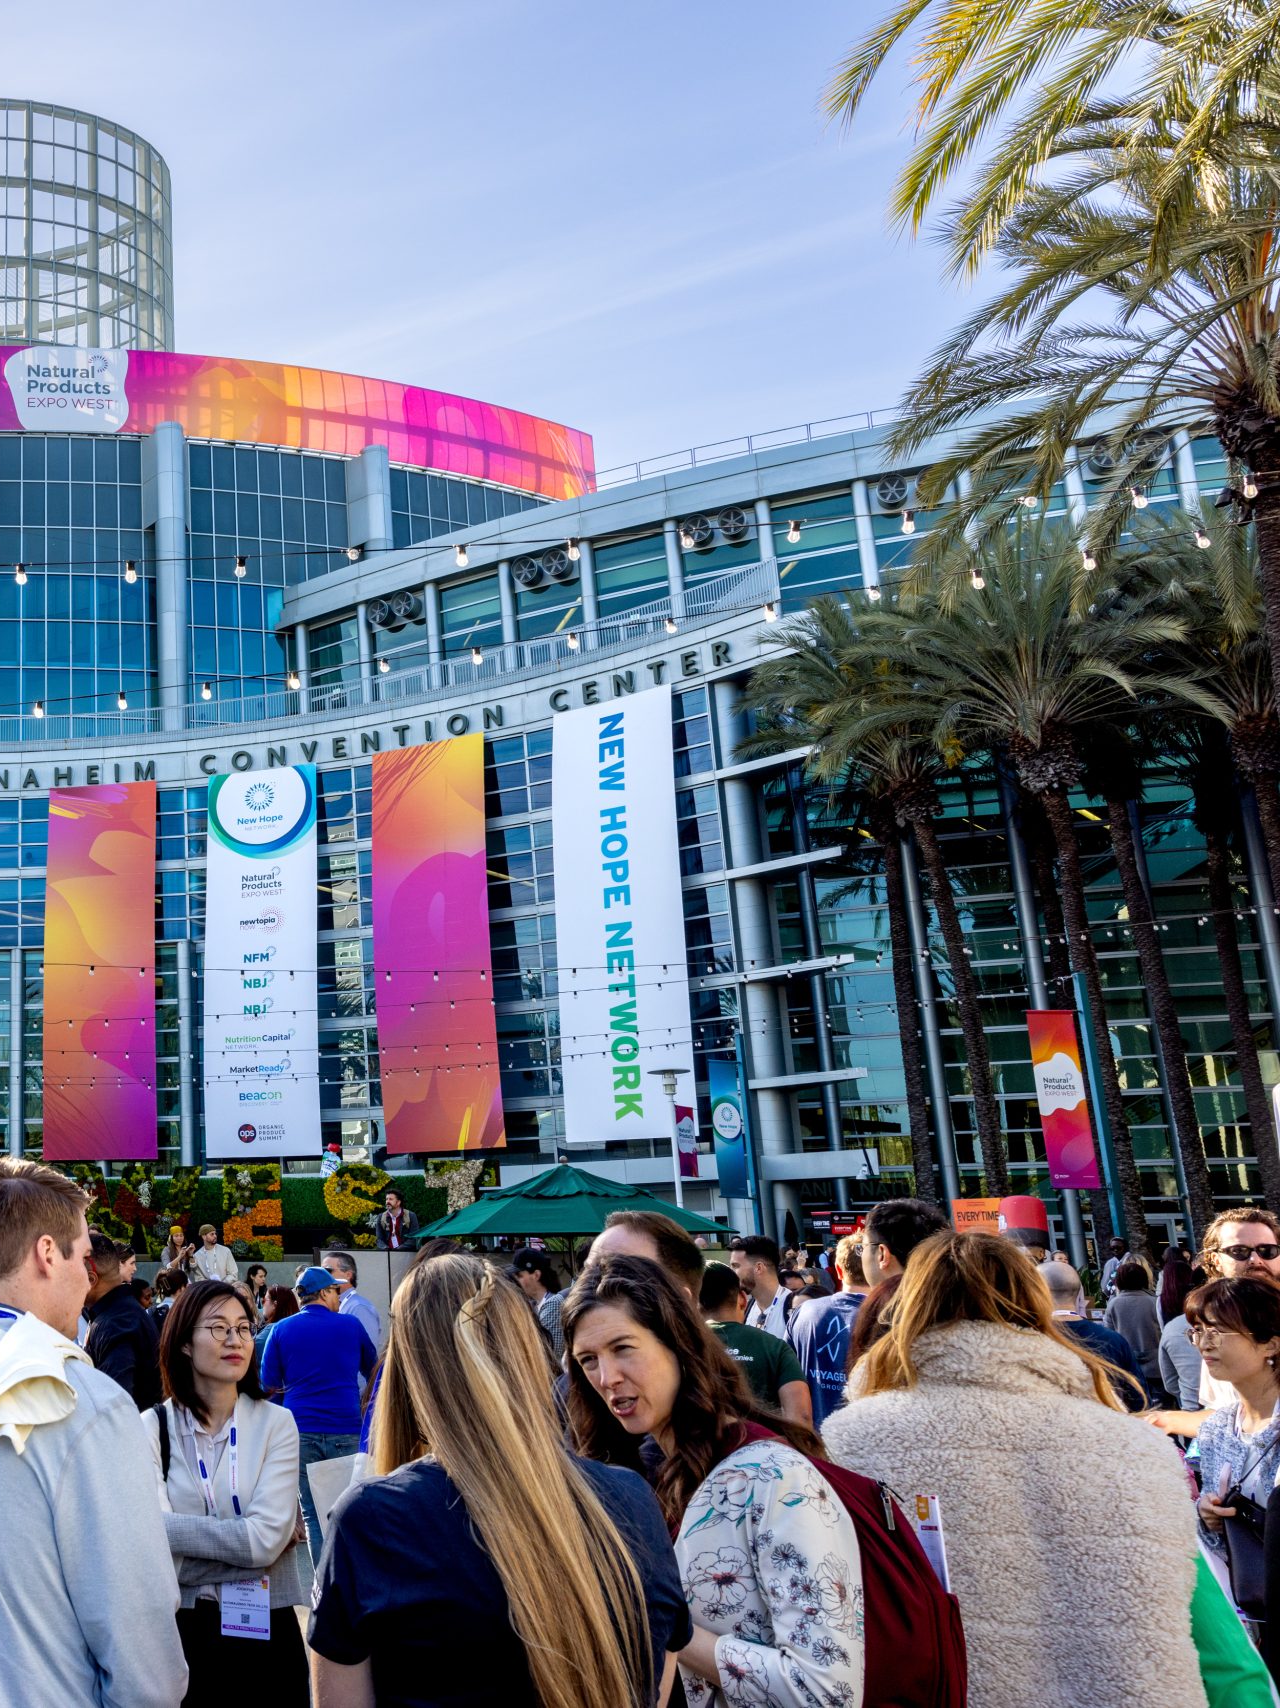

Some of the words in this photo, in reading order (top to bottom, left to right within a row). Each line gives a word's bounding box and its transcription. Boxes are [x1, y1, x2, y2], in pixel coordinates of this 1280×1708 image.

[27, 365, 95, 379] Natural
[27, 380, 110, 395] Products
[27, 398, 67, 408] EXPO
[72, 398, 113, 410] WEST
[199, 704, 504, 776] CONVENTION
[550, 640, 732, 713] CENTER
[599, 712, 626, 792] NEW
[237, 817, 257, 825] New
[259, 814, 283, 823] Hope
[600, 805, 632, 910] HOPE
[241, 872, 275, 882] Natural
[241, 880, 282, 890] Products
[241, 890, 261, 898] EXPO
[240, 916, 276, 925] newtopia
[243, 953, 269, 963] NFM
[243, 978, 267, 989] NBJ
[243, 1004, 267, 1015] NBJ
[605, 921, 644, 1121] NETWORK
[1043, 1083, 1076, 1091] Products
[239, 1091, 282, 1101] Beacon
[240, 1130, 255, 1139] ops
